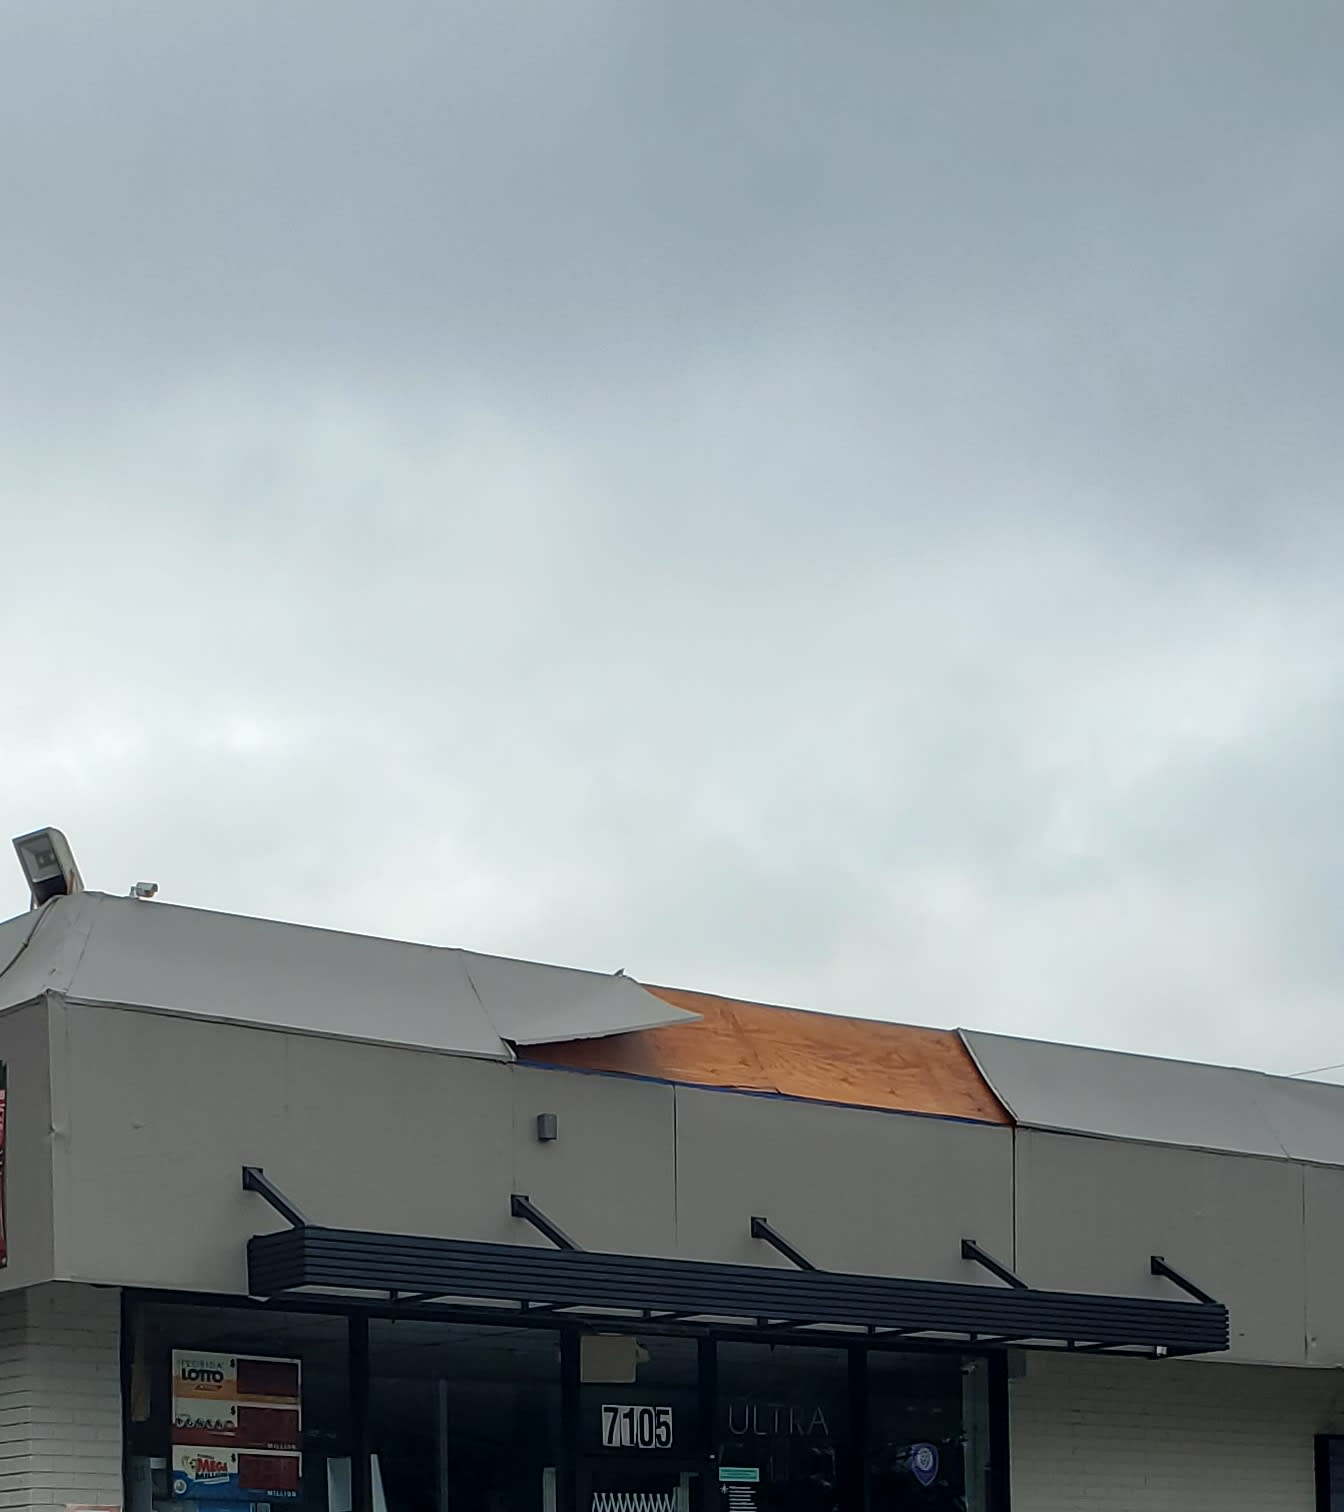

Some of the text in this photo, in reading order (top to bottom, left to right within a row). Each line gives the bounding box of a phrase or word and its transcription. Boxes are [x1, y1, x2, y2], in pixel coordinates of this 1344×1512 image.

[181, 1368, 224, 1383] LOTTO
[602, 1405, 672, 1448] 7105
[728, 1403, 829, 1436] ULTRA
[197, 1457, 228, 1473] MEGA
